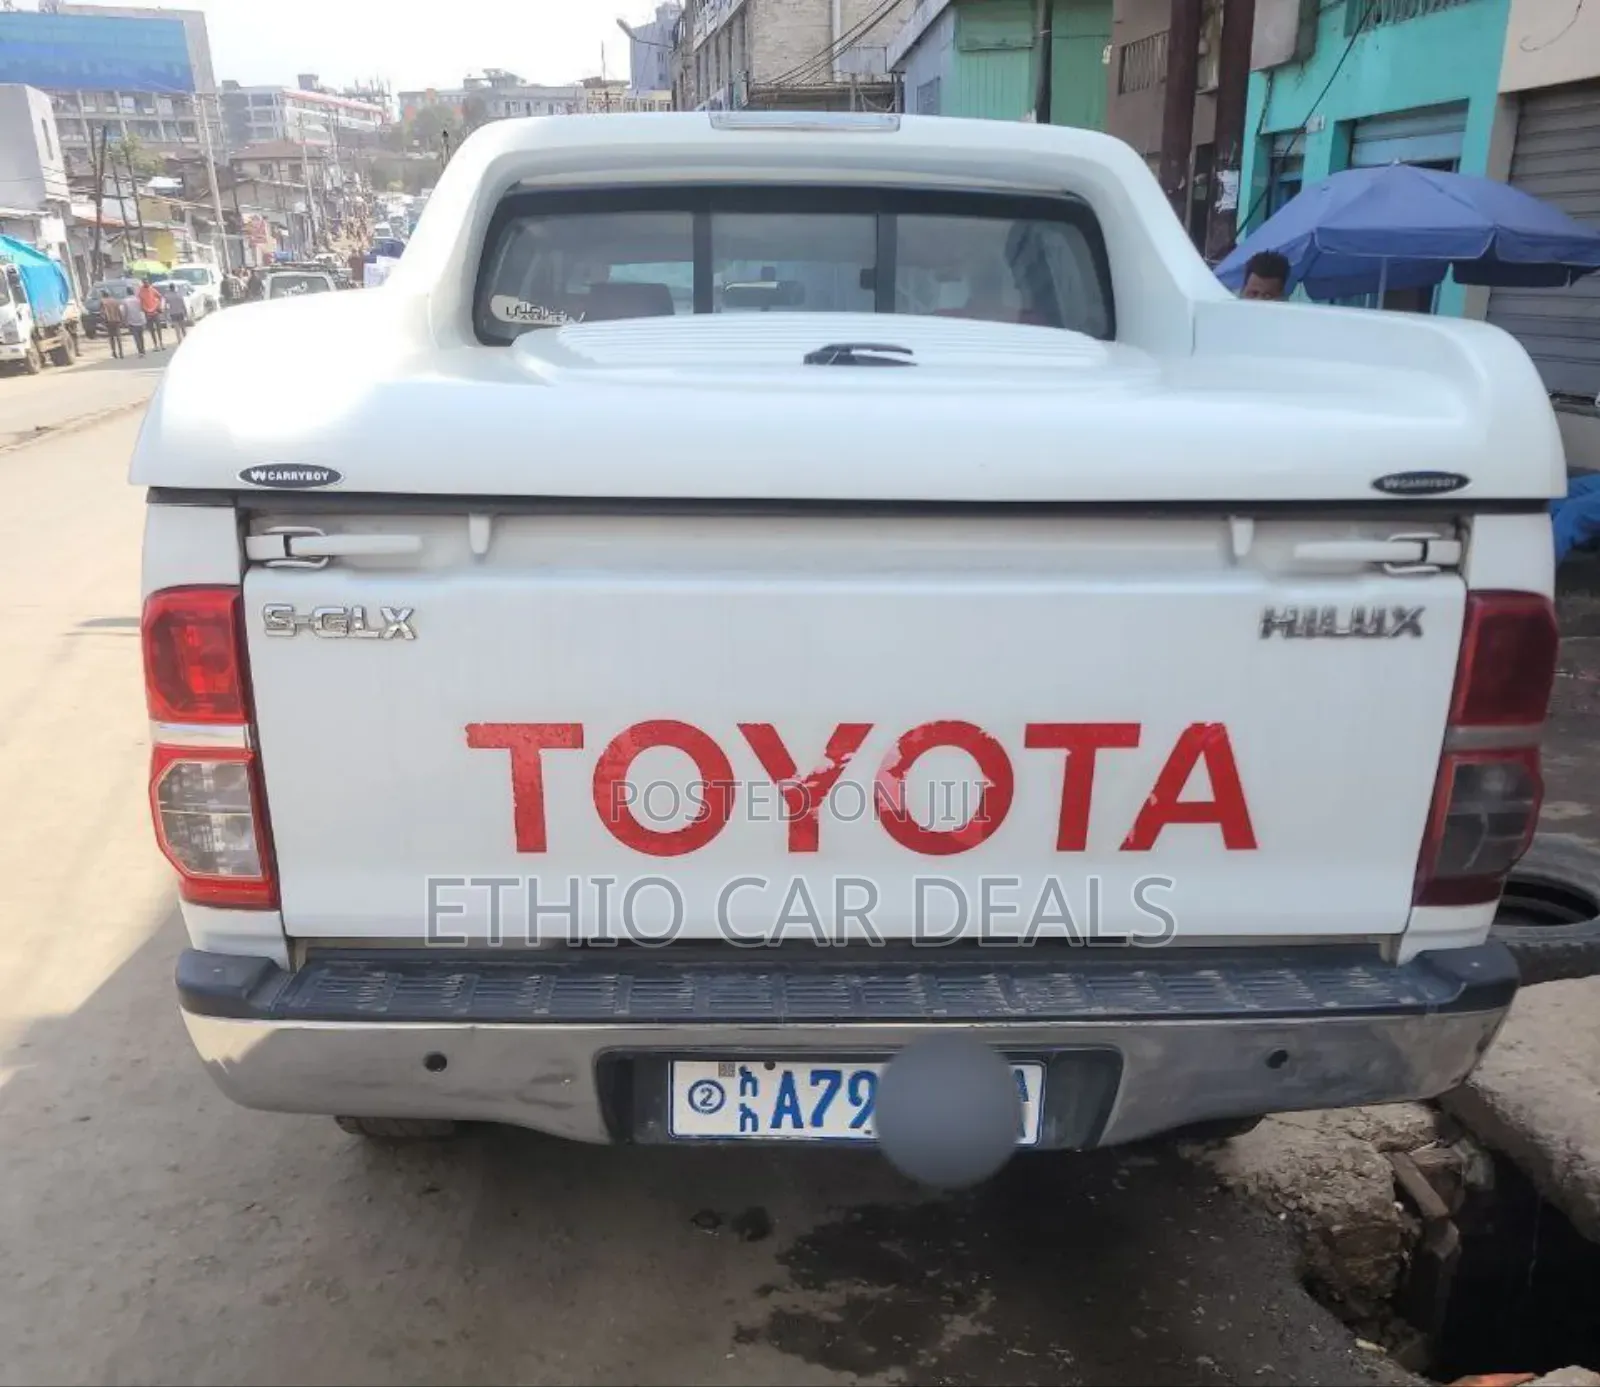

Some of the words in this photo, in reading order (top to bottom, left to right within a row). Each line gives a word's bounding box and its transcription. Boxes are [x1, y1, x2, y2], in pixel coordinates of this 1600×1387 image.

[263, 602, 416, 640] S-GLX
[1260, 605, 1426, 640] HILUX
[466, 719, 1259, 857] TOYOTA
